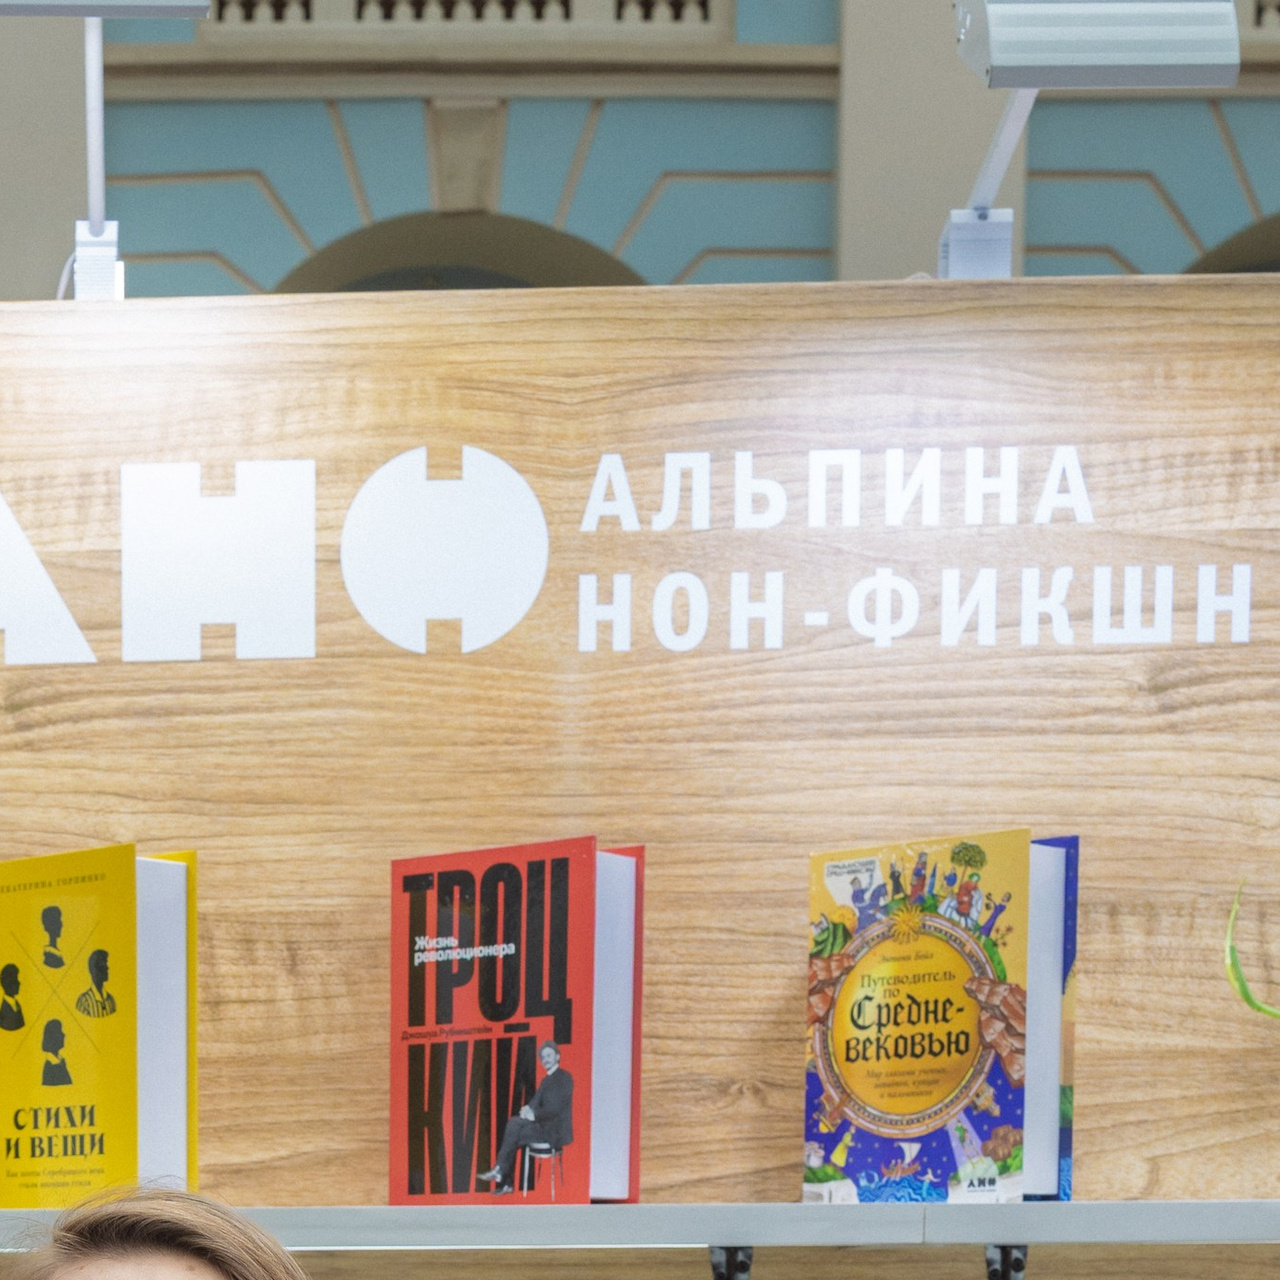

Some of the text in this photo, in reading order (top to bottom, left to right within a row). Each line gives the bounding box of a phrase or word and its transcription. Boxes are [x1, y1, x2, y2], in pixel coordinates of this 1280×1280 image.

[581, 445, 1095, 531] АЛЬПИНА
[578, 563, 1251, 652] НОН-ФИКШН
[403, 857, 573, 1045] ТРОЦ
[414, 943, 516, 966] революционера
[415, 936, 458, 951] Жизнь
[860, 971, 956, 988] Путеводитель
[883, 988, 900, 999] по
[850, 994, 965, 1035] Средне-
[845, 1030, 970, 1063] вековью
[13, 1104, 95, 1131] СТИХИ
[4, 1132, 105, 1159] И ВЕЩИ
